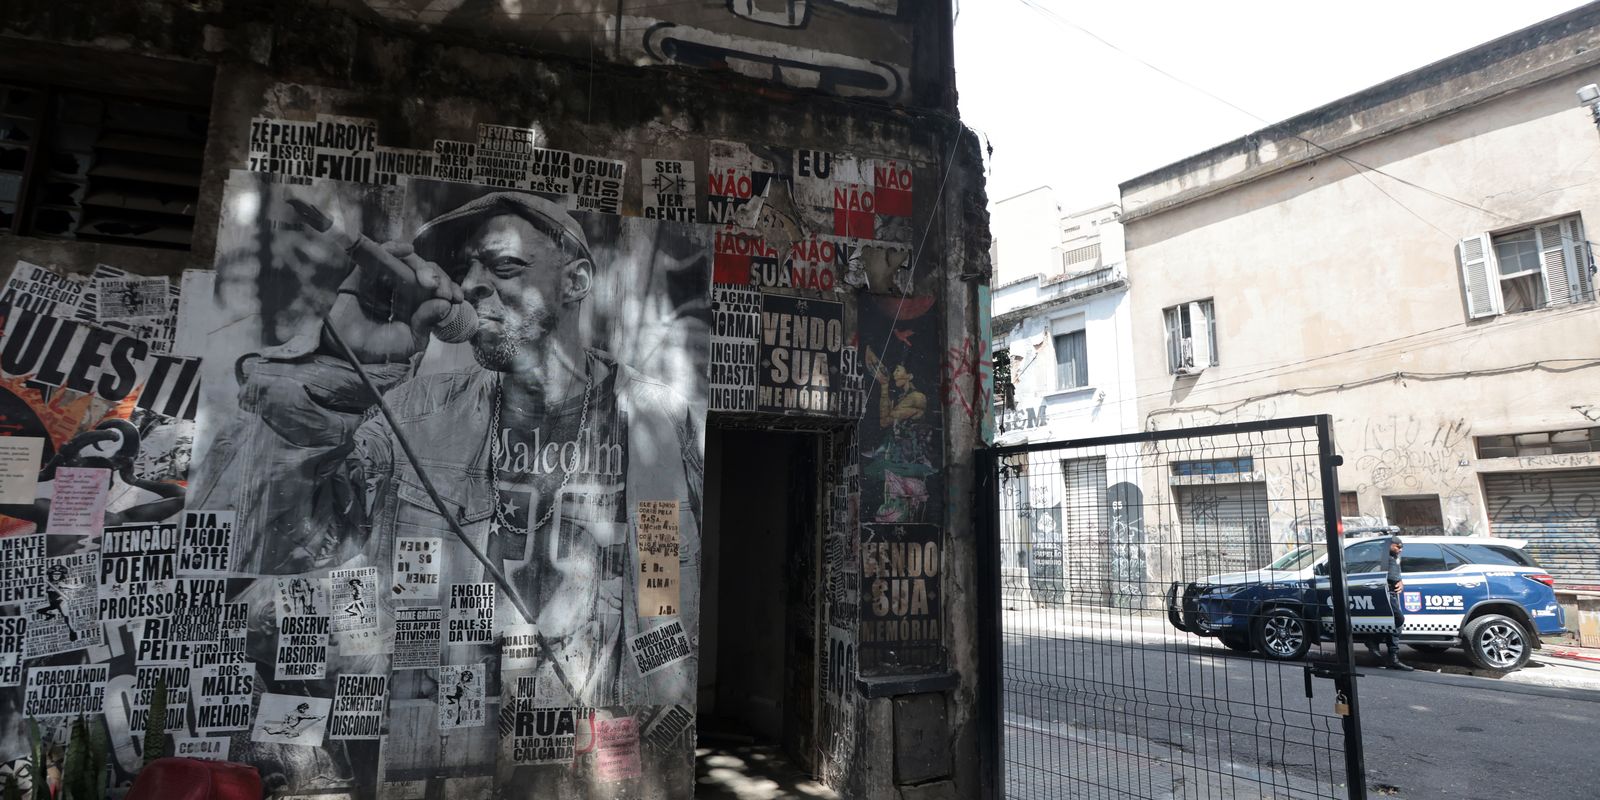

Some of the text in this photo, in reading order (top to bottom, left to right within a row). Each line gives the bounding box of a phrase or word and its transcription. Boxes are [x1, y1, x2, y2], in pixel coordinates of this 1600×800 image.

[316, 121, 377, 152] LAROYÊ
[270, 144, 315, 161] DESCEU
[435, 141, 475, 157] SONHO
[534, 149, 570, 166] VIVA
[440, 154, 469, 168] MEU
[573, 157, 623, 179] OGUM
[655, 161, 682, 174] SER
[799, 151, 830, 179] EU
[433, 165, 473, 180] PESADELO
[532, 162, 571, 179] COMO
[874, 160, 912, 190] NÃO
[709, 168, 752, 200] NÃO
[657, 193, 684, 207] VER
[834, 183, 874, 213] NÃO
[708, 198, 738, 224] NÃ
[791, 231, 835, 263] NÃO
[792, 262, 833, 290] NÃO
[9, 278, 28, 291] QUE
[29, 282, 79, 306] CHEGUEI
[711, 311, 761, 339] NORMAL
[762, 311, 841, 352] VENDO
[771, 347, 830, 387] SUA
[758, 385, 838, 412] MEMÓRIA
[186, 513, 216, 528] DIA
[3, 536, 44, 550] MENTE
[104, 525, 176, 556] ATENÇÃO!
[183, 529, 231, 546] PAGODE
[101, 555, 174, 585] POEMA
[180, 554, 228, 570] NOITE
[130, 583, 148, 596] EM
[175, 580, 225, 593] A VIDA
[451, 584, 494, 597] ENGOLE
[176, 593, 222, 608] REAL
[450, 596, 494, 609] A MORTE
[872, 579, 929, 616] SUA
[1425, 595, 1464, 607] IOPE
[100, 593, 174, 620] PROCESSO
[478, 609, 493, 619] NO
[281, 616, 330, 635] OBSERVE
[396, 622, 441, 631] SEU APP DE
[449, 619, 493, 630] CALE-SE
[862, 616, 940, 641] MEMÓRIA
[290, 635, 318, 646] MAIS
[395, 630, 441, 641] ATIVISMO
[449, 630, 493, 642] DA VIDA
[634, 621, 683, 651] CRACOLÂNDIA
[278, 646, 326, 664] ABSORVA
[643, 636, 678, 658] LOTADA
[193, 652, 245, 669] LIMITES
[638, 642, 691, 674] SCHADENFREUDE
[36, 666, 106, 686] CRACOLÂNDIA
[136, 667, 190, 689] REGANDO
[218, 665, 240, 677] DOS
[285, 664, 317, 676] MENOS
[41, 683, 91, 699] LOTADA
[94, 687, 105, 696] DE
[202, 675, 254, 696] MALES
[338, 676, 385, 696] REGANDO
[25, 696, 104, 716] SCHADENFREUDE
[223, 696, 229, 705] O
[340, 696, 374, 711] SEMENTE
[199, 704, 250, 728] MELHOR
[332, 711, 380, 736] DISCÓRDIA
[515, 711, 575, 737] RUA
[514, 736, 575, 748] E NÃO TÁ NEM
[513, 747, 574, 763] CALÇADA
